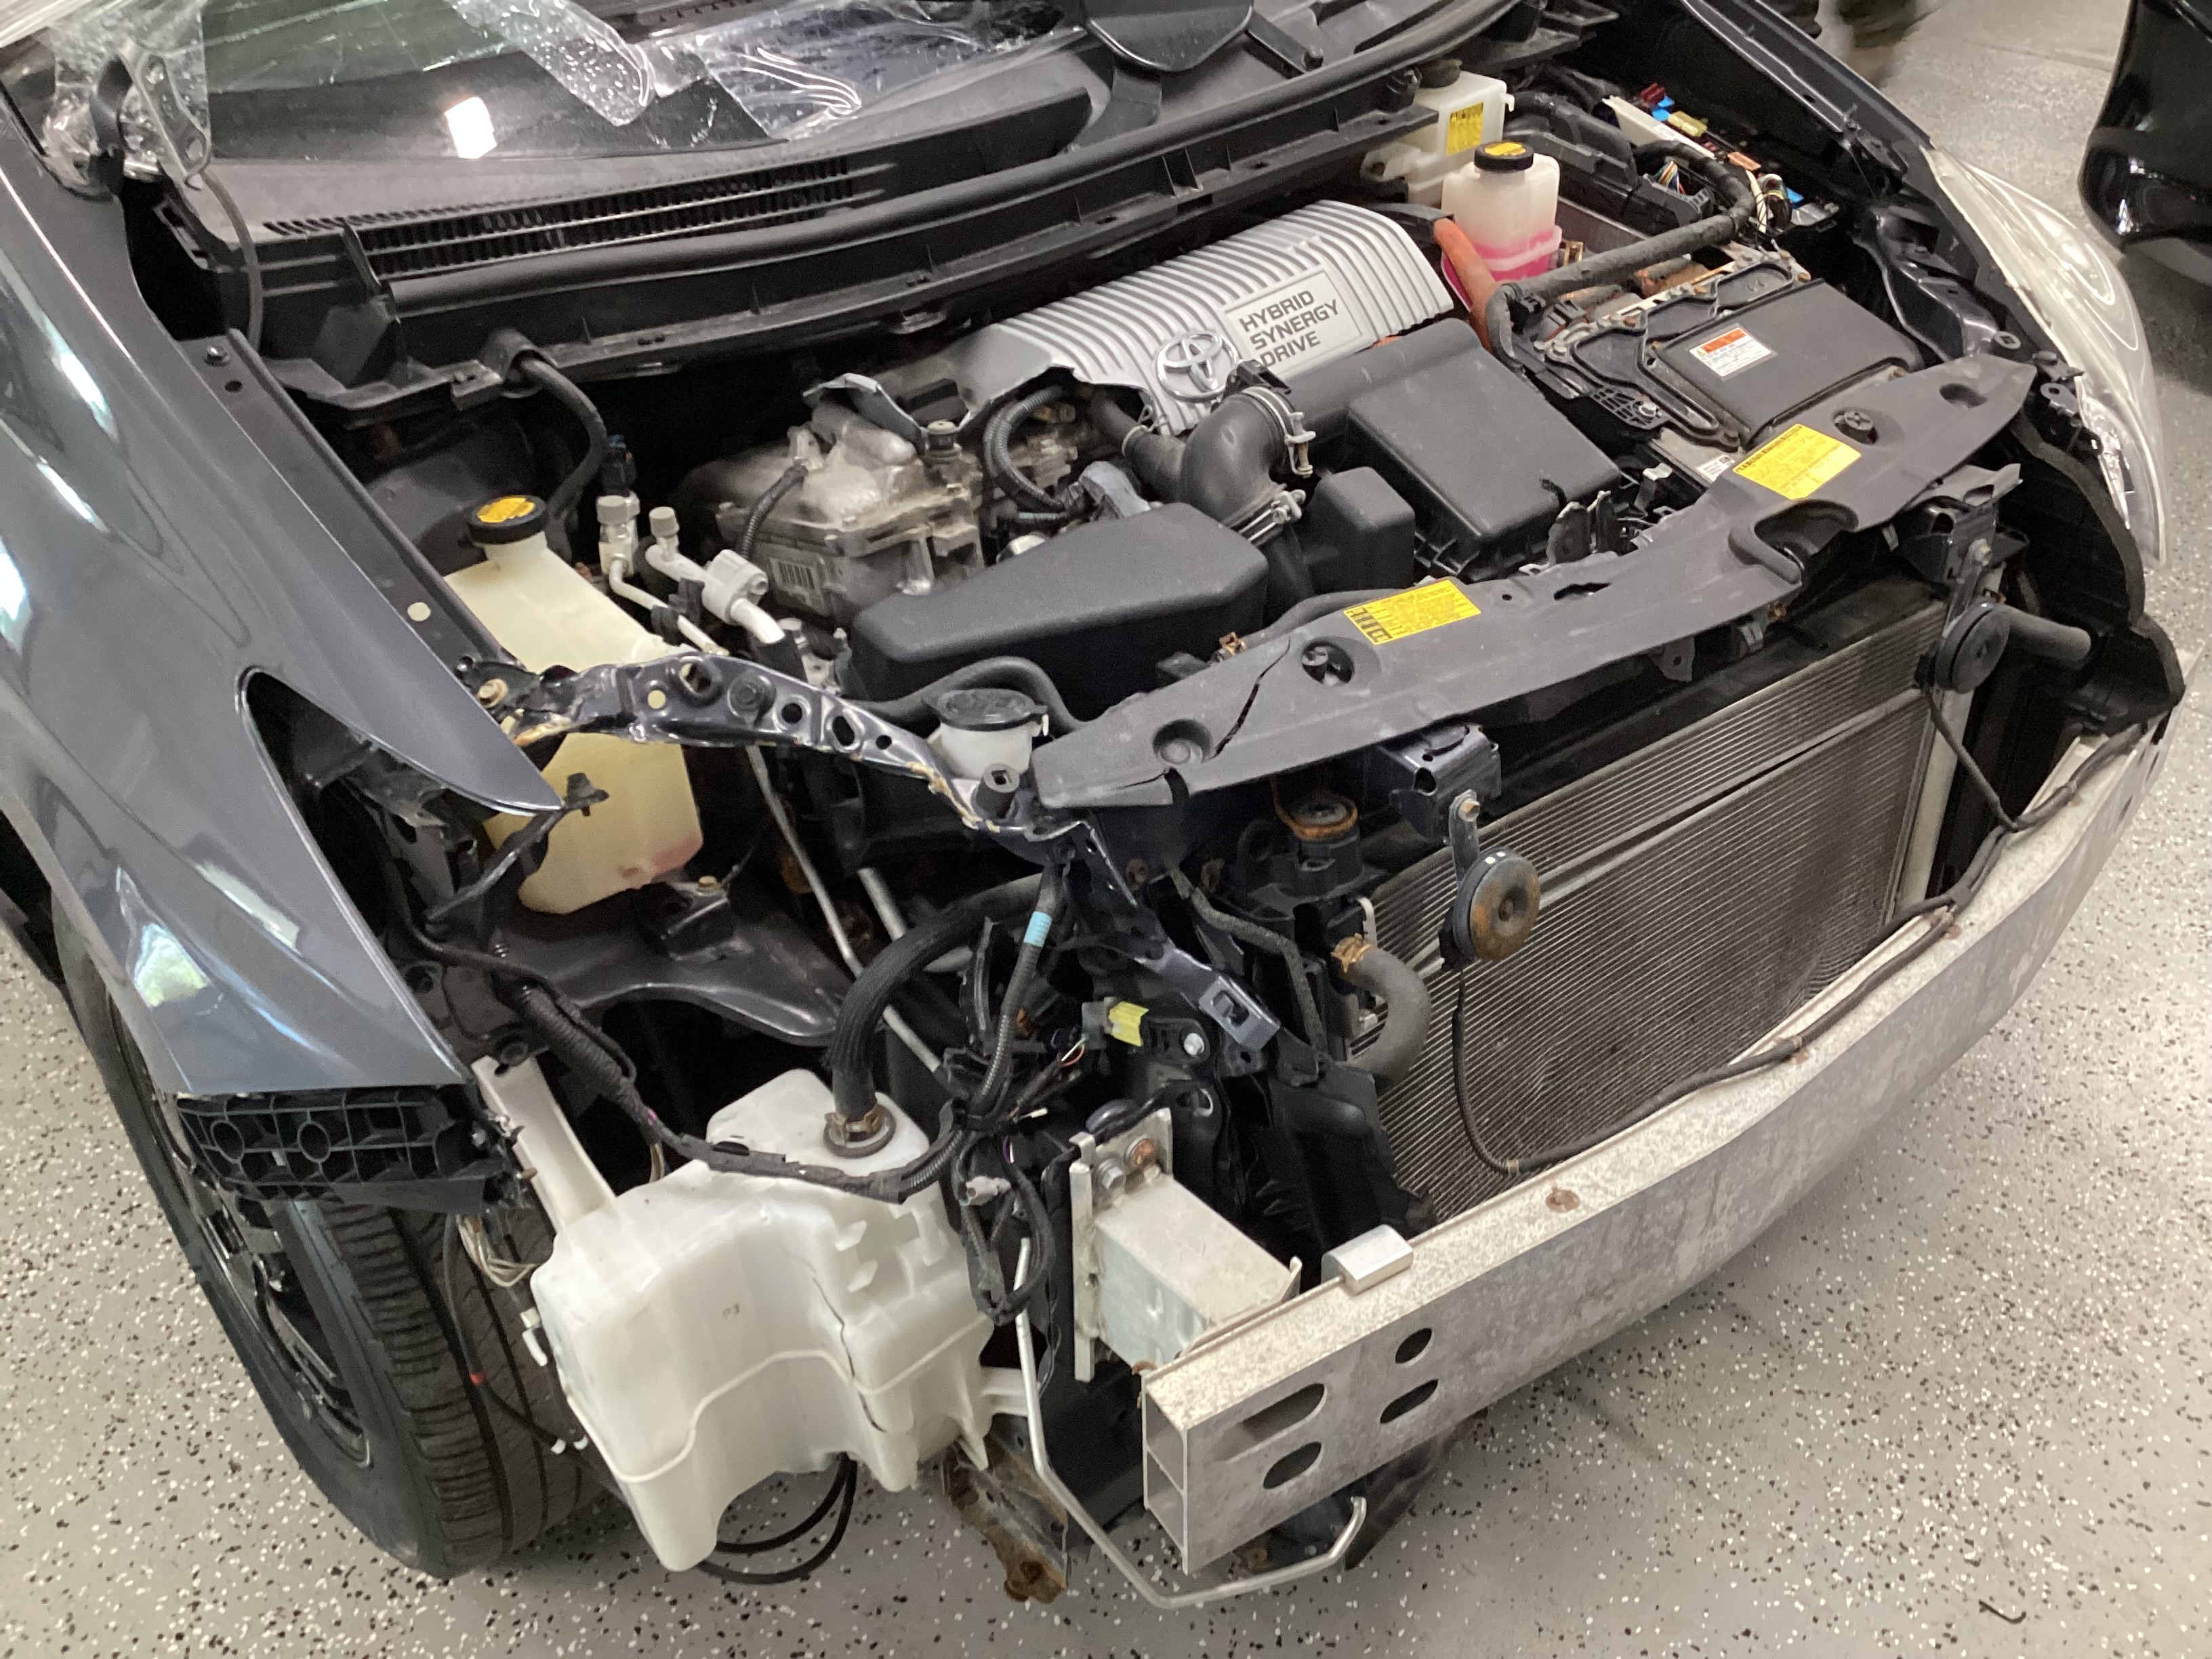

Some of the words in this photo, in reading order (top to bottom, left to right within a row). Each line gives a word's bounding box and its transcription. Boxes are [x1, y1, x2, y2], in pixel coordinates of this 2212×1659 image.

[1239, 290, 1314, 332] HYBRID
[1250, 299, 1338, 350] SYNERGY
[1260, 331, 1321, 367] DRIVE
